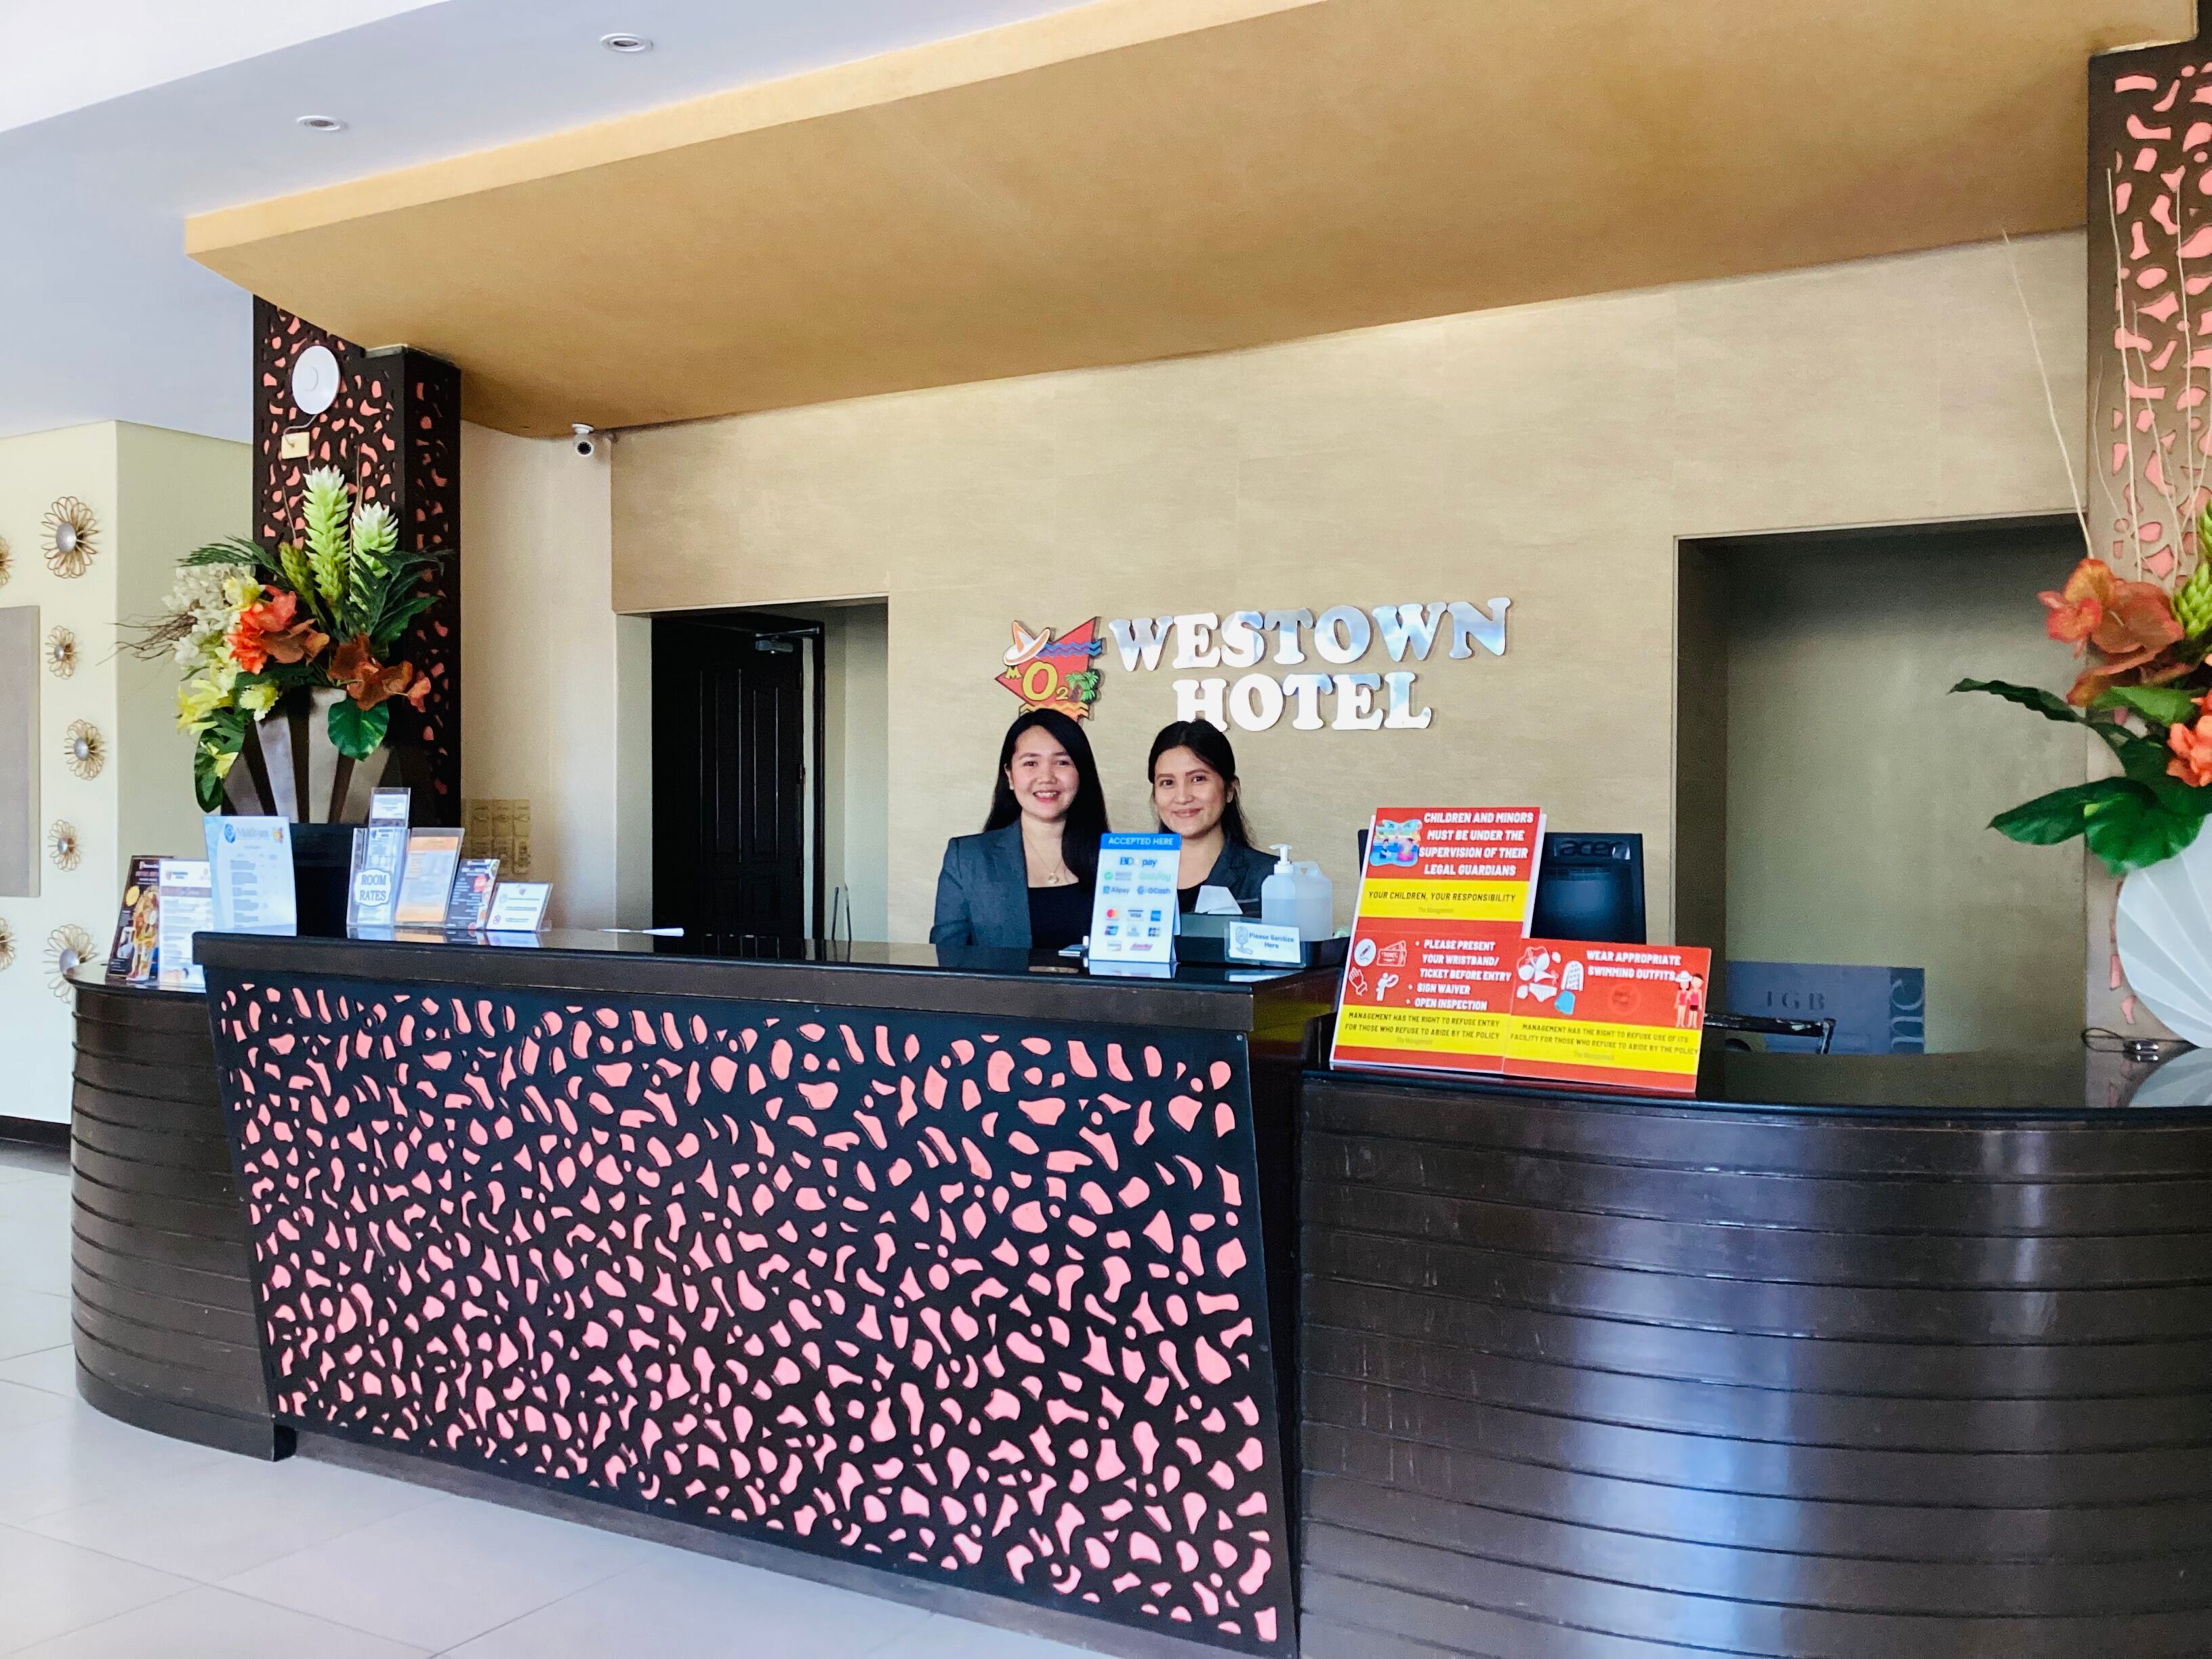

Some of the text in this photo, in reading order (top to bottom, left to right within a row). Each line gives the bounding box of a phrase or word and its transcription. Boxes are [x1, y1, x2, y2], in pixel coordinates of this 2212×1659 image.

[1108, 597, 1511, 671] WESTOWN
[1172, 672, 1433, 731] HOTEL
[1424, 813, 1534, 823] CHILDREN AND MINORS
[1108, 837, 1174, 845] ACCEPTED HERE
[1427, 830, 1525, 841] MUST BE UNDER THE
[1419, 847, 1529, 859] SUPERVISION OF THEIR
[1559, 841, 1625, 856] acer
[1142, 859, 1158, 867] pay
[1424, 865, 1516, 876] LEGAL GUARDIANS
[361, 874, 386, 885] ROOM
[359, 890, 386, 901] RATES
[1369, 891, 1516, 902] YOUR CHILDREN, YOUR RESPONSIBILITY
[1424, 939, 1496, 951] PLEASE PRESENT
[1422, 954, 1500, 966] YOUR WRISTBAND/
[1586, 950, 1681, 966] WEAR APPROPRIATE
[1420, 968, 1512, 981] TICKET BEFORE ENTRY
[1588, 966, 1675, 981] SWIMMING OUTFITS
[1417, 983, 1471, 995] SIGN WAIVER
[1414, 998, 1488, 1010] OPEN INSPECTION
[1349, 1012, 1392, 1021] MANAGEMENT
[1408, 1015, 1420, 1023] THE
[1421, 1016, 1440, 1024] RIGHT
[1452, 1017, 1475, 1026] REFUSE
[1477, 1019, 1500, 1027] ENTRY
[1358, 1024, 1378, 1032] THOSE
[1380, 1025, 1394, 1033] WHO
[1395, 1026, 1420, 1034] REFUSE
[1431, 1029, 1450, 1037] ABIDE
[1452, 1029, 1460, 1038] BY
[1462, 1030, 1474, 1038] THE
[1476, 1031, 1500, 1040] POLICY
[1522, 1023, 1688, 1043] MANAGEMENT HAS THE RIGHT TO REFUSE USE OF ITS
[1510, 1033, 1700, 1055] FACILITY FOR THOSE WHO REFUSE TO ABIDE BY THE POLICY
